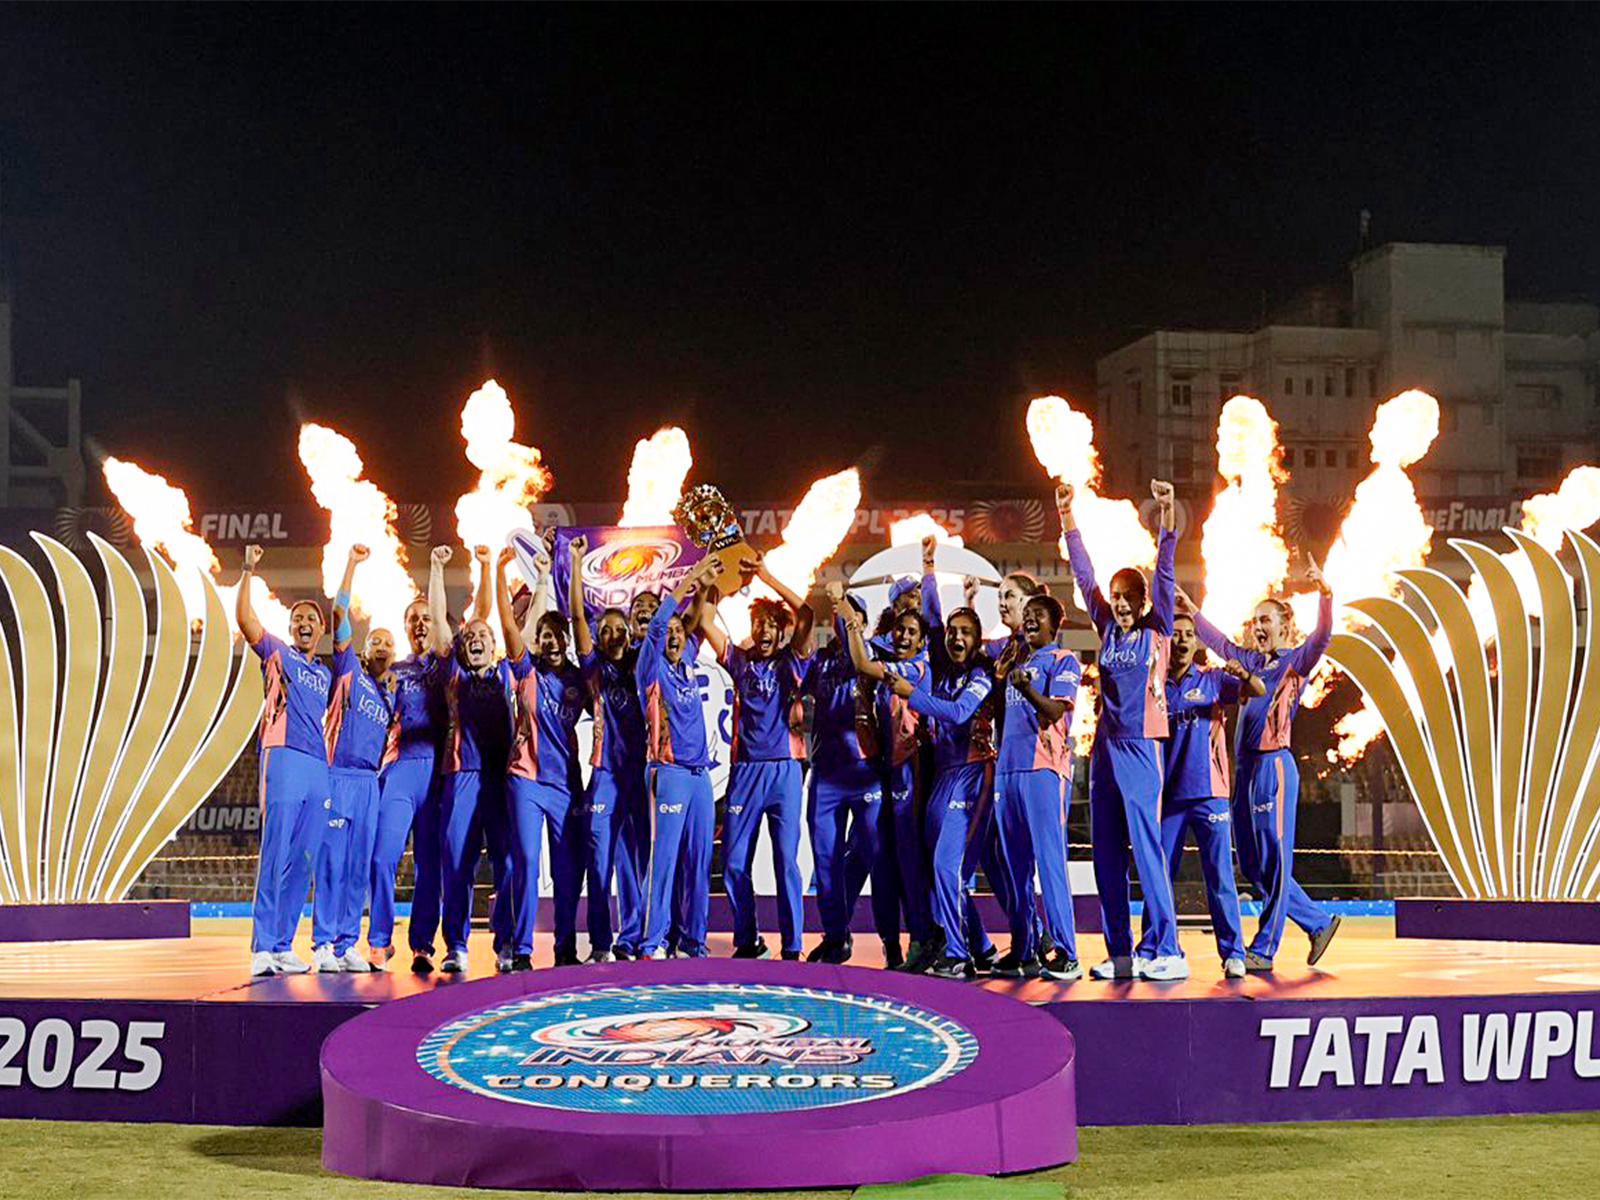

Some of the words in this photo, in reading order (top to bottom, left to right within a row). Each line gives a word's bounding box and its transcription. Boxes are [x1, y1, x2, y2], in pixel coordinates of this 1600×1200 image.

[201, 513, 288, 540] FINAL
[0, 1017, 166, 1092] 2025
[518, 1046, 876, 1065] INDIANS
[1260, 1015, 1445, 1089] TATA
[1462, 1010, 1600, 1083] WPL
[483, 1073, 896, 1091] CONQUERORS
